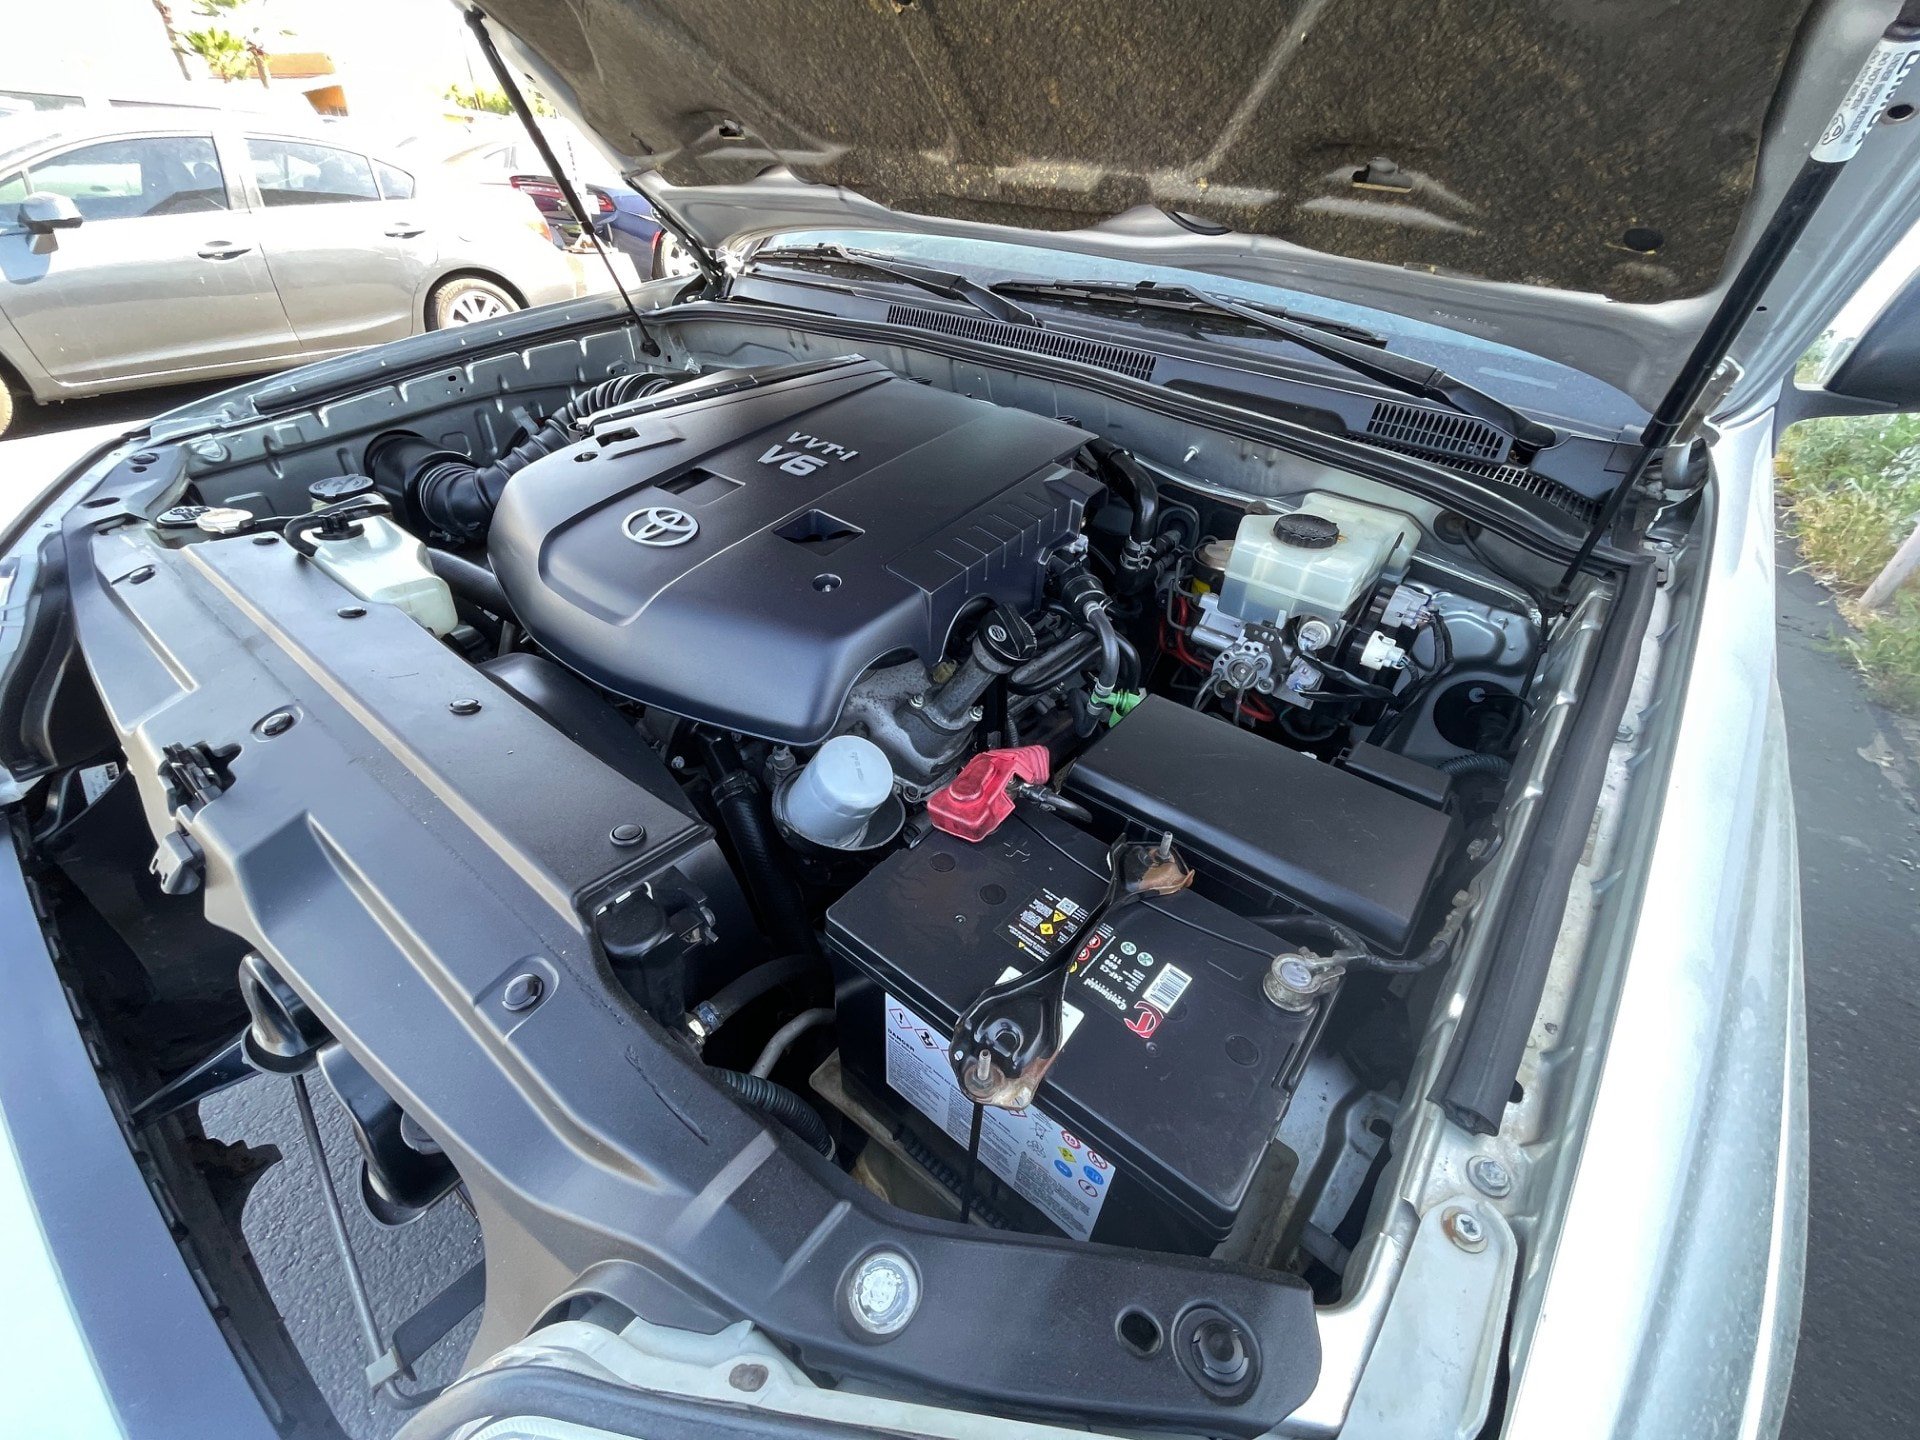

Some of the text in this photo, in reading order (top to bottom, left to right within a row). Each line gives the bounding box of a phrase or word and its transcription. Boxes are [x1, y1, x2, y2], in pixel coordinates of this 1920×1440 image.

[1864, 66, 1882, 87] NOT
[757, 444, 829, 476] V6
[1083, 977, 1127, 1010] Continental
[887, 1027, 915, 1052] DANGER
